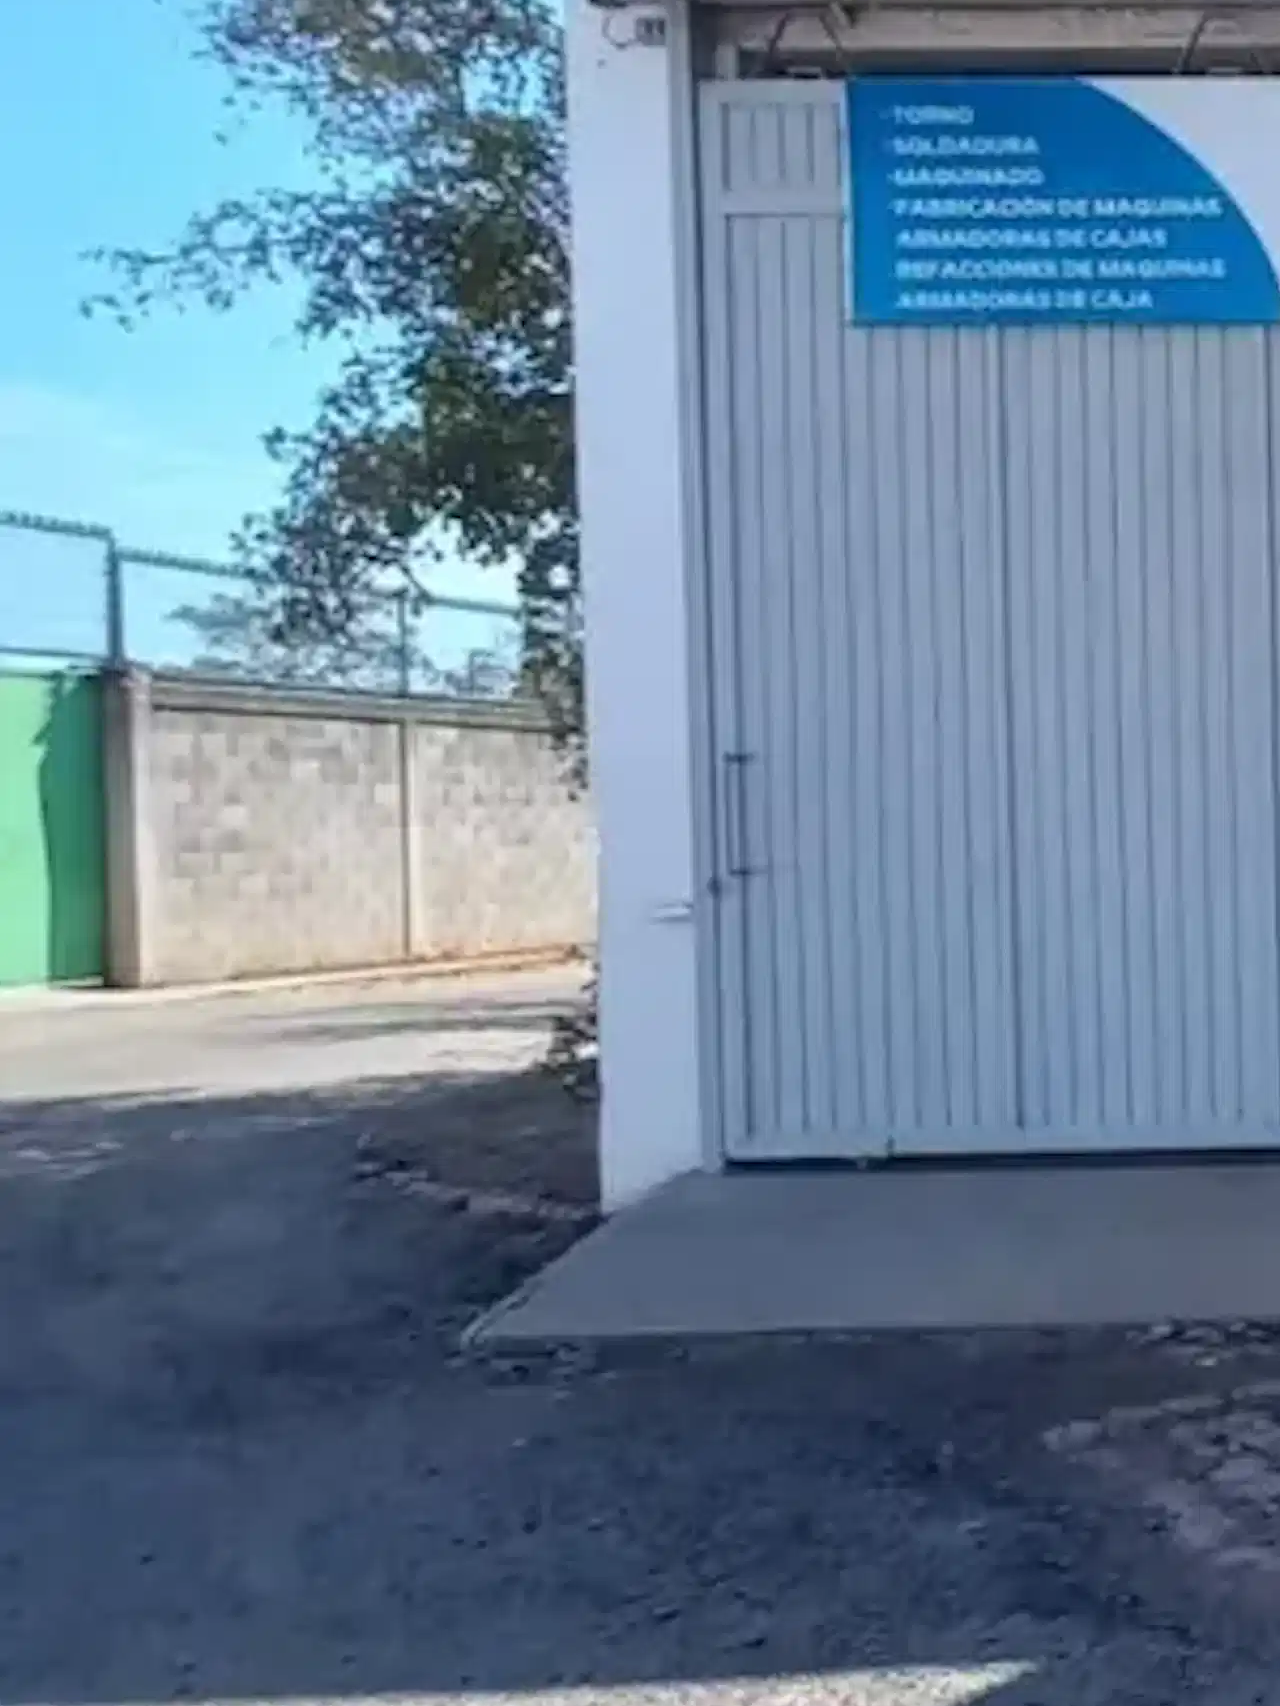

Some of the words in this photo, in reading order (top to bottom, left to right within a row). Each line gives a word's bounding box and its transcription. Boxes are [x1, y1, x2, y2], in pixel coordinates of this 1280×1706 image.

[894, 105, 974, 125] TORNO
[894, 136, 1039, 156] SOLDADURA
[894, 167, 1045, 186] MAQUINADO
[1056, 198, 1089, 218] DE
[896, 227, 1050, 249] ARMADORAS
[1054, 228, 1086, 248] DE
[1091, 227, 1168, 249] CAJAS
[895, 258, 1059, 280] REFACCIONES
[1060, 258, 1093, 279] DE
[896, 289, 1050, 310] ARMADORAS
[1054, 289, 1086, 309] DE
[1091, 289, 1153, 310] CAJA
